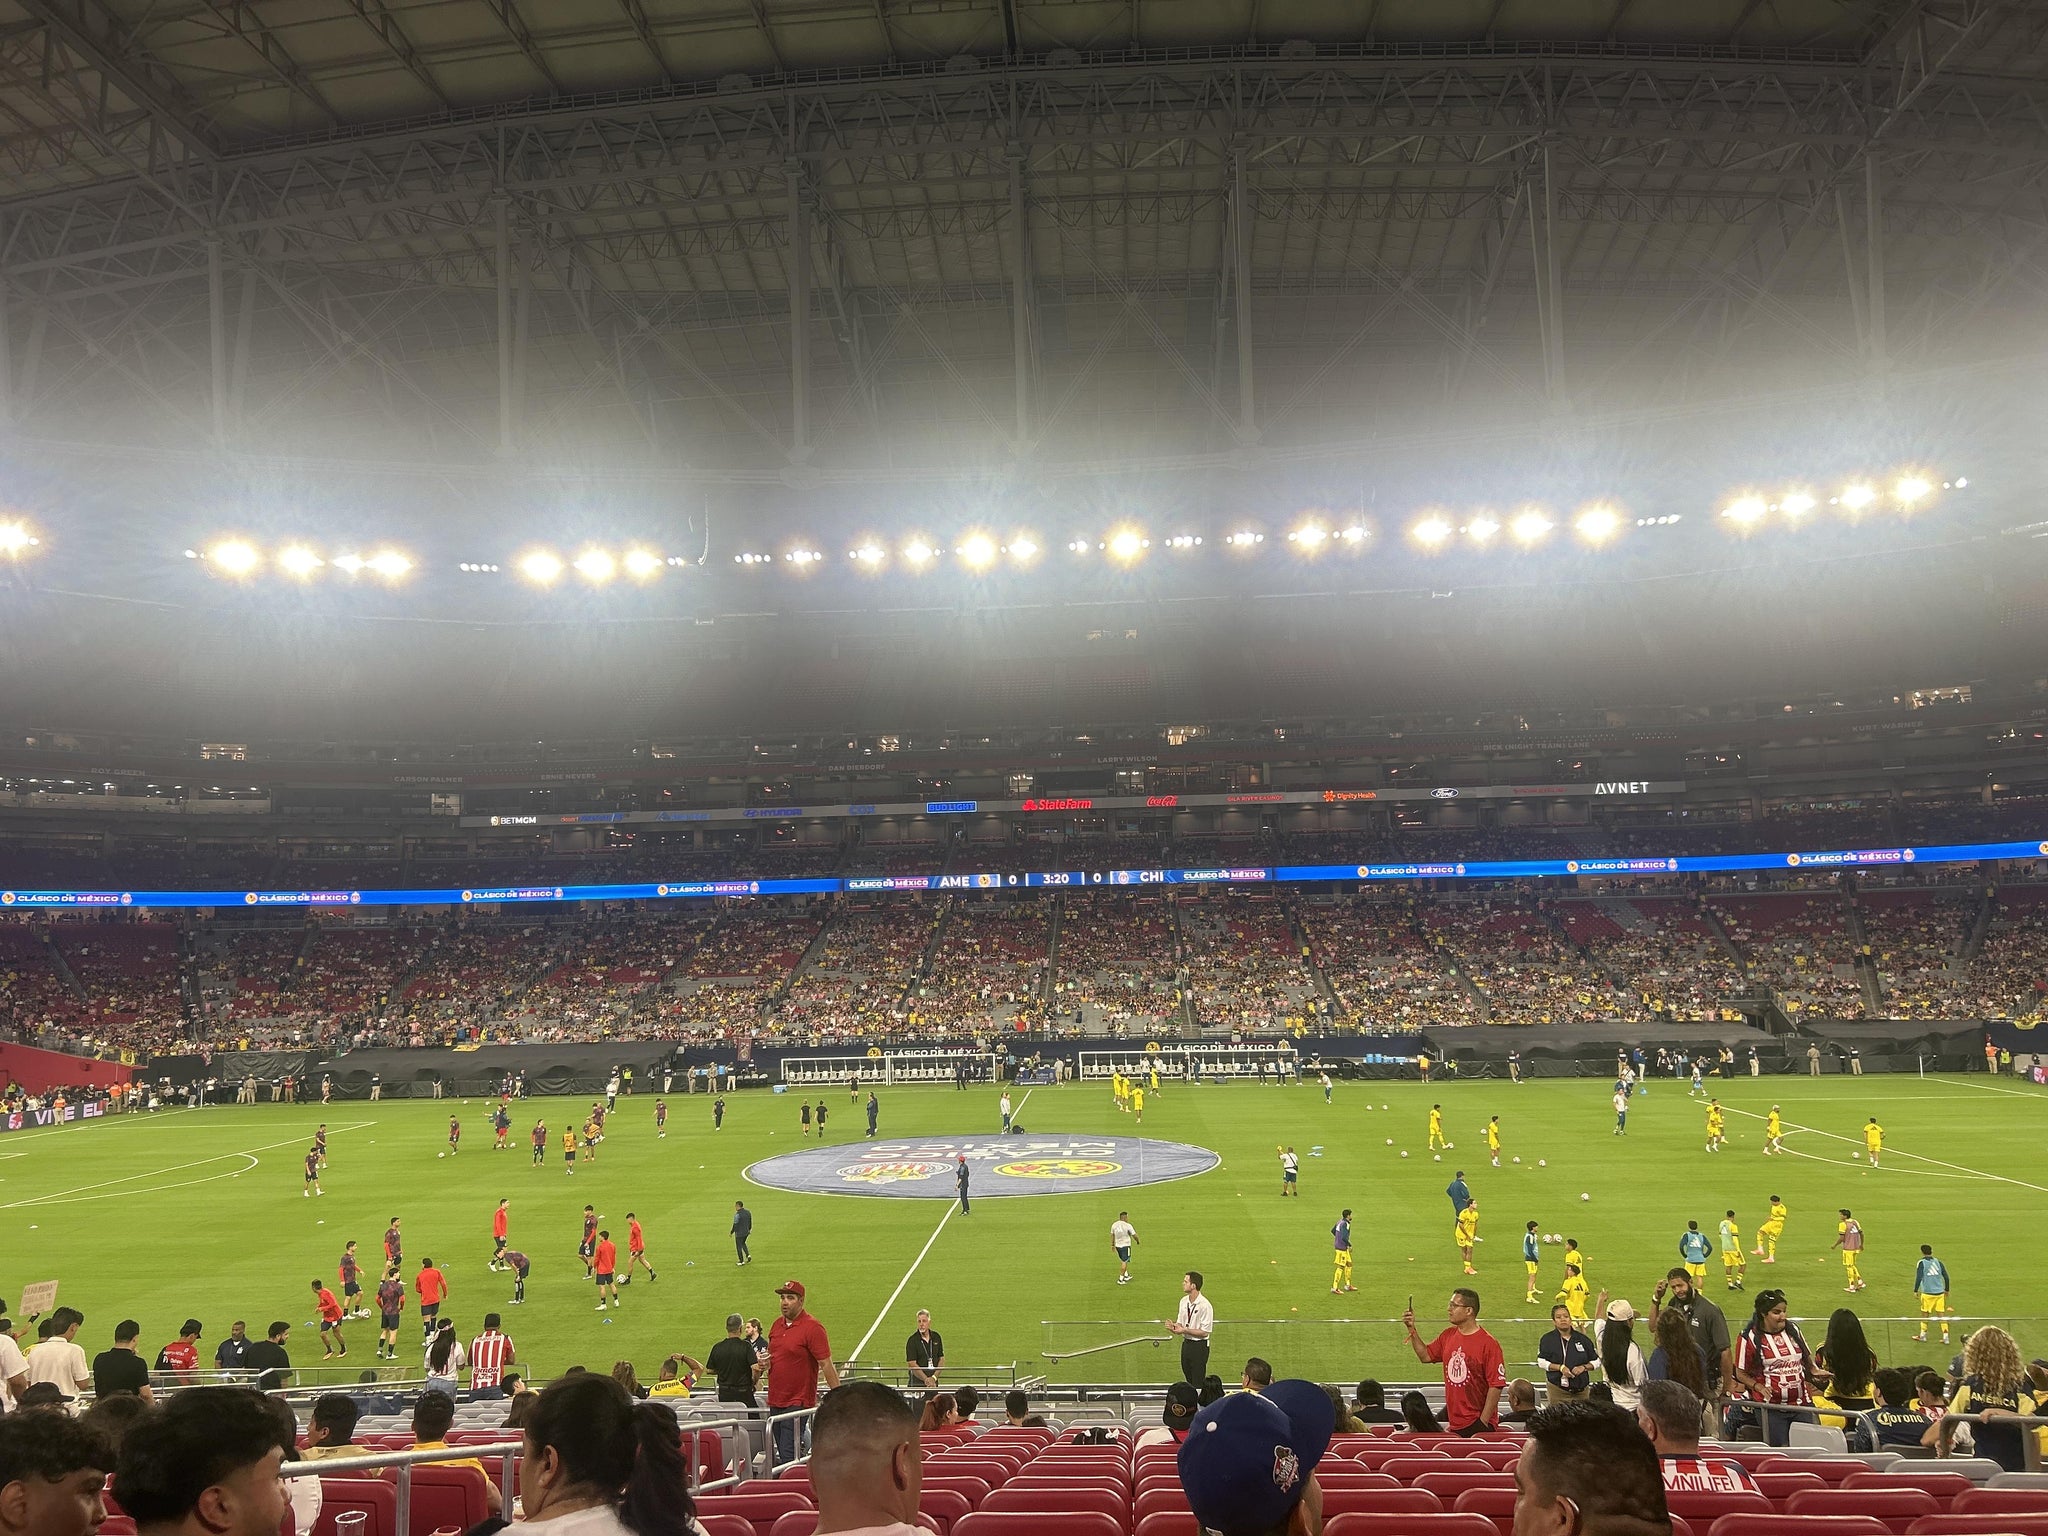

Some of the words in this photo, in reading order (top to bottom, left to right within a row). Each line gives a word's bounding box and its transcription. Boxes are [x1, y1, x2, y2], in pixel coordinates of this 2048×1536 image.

[1852, 724, 1878, 732] KURT
[1880, 720, 1923, 729] WARNER
[847, 763, 886, 771] DIERDORF
[114, 768, 145, 776] GREEN
[1595, 781, 1649, 794] AVNET
[1436, 788, 1454, 797] Ford
[760, 808, 802, 816] HYUNDAI
[500, 816, 537, 825] BETMGM
[1802, 854, 1843, 862] CLÁSICO
[1859, 852, 1901, 861] MÉXICO
[1370, 867, 1405, 875] CLÁSICO
[849, 880, 883, 888] CLÁSICO
[895, 879, 929, 887] MÉXICO
[940, 876, 970, 887] AME
[1008, 875, 1017, 885] 0
[1043, 874, 1070, 884] 3:20
[1093, 873, 1102, 883] 0
[1140, 871, 1164, 882] CHI
[1183, 871, 1218, 879] CLÁSICO
[77, 894, 119, 902] MÉXICO
[473, 891, 506, 899] CLÁSICO
[883, 1047, 929, 1057] CLÁSICO
[1162, 1043, 1208, 1052] CLÁSICO
[1228, 1043, 1275, 1051] MÉXICO
[83, 1103, 103, 1118] EL
[1877, 1411, 1925, 1427] Corona
[1663, 1475, 1736, 1491] MNILIFE
